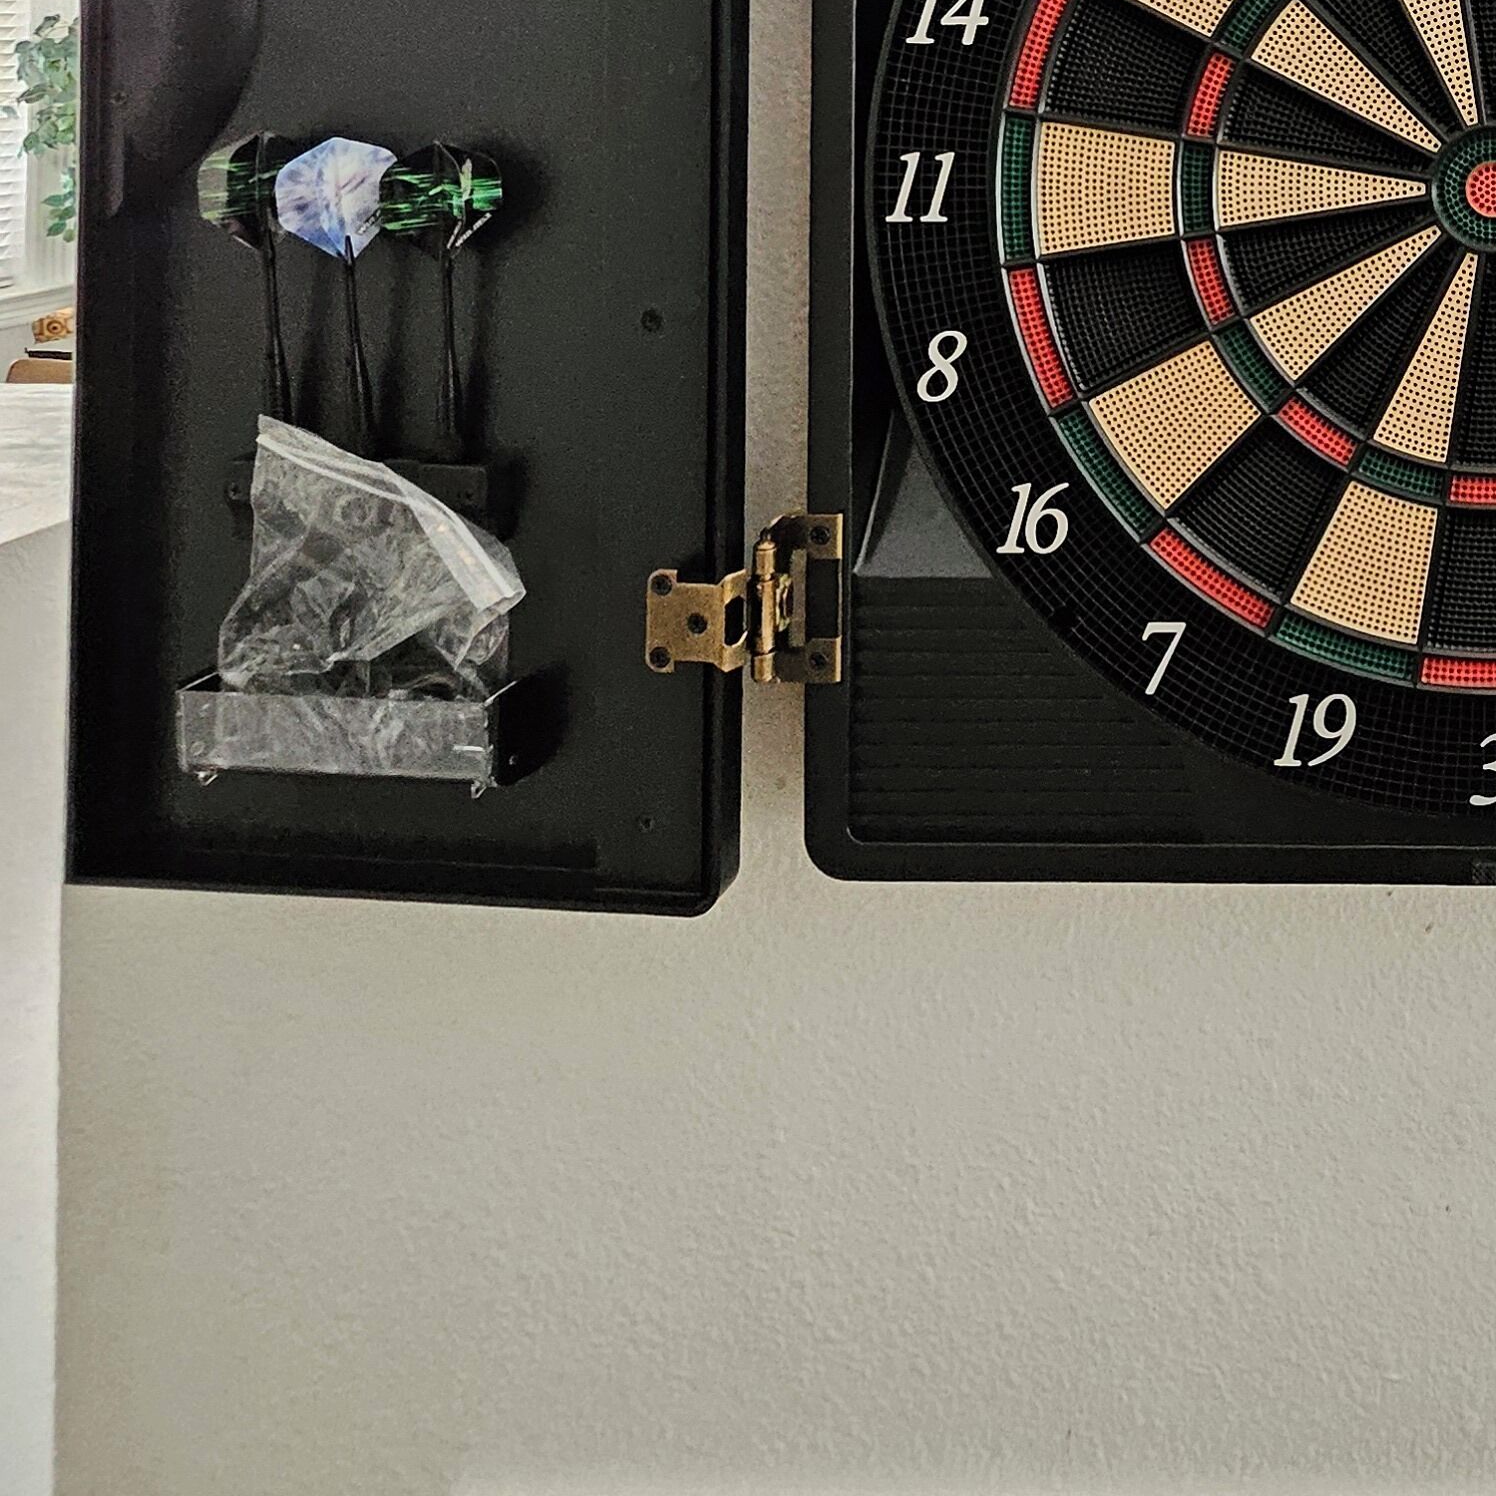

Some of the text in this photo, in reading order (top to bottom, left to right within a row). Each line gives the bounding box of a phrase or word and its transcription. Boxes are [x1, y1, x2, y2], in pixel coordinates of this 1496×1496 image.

[885, 152, 955, 222] 11
[917, 331, 967, 402] 8
[996, 483, 1069, 554] 16
[1142, 622, 1186, 695] 7
[1274, 694, 1356, 766] 19
